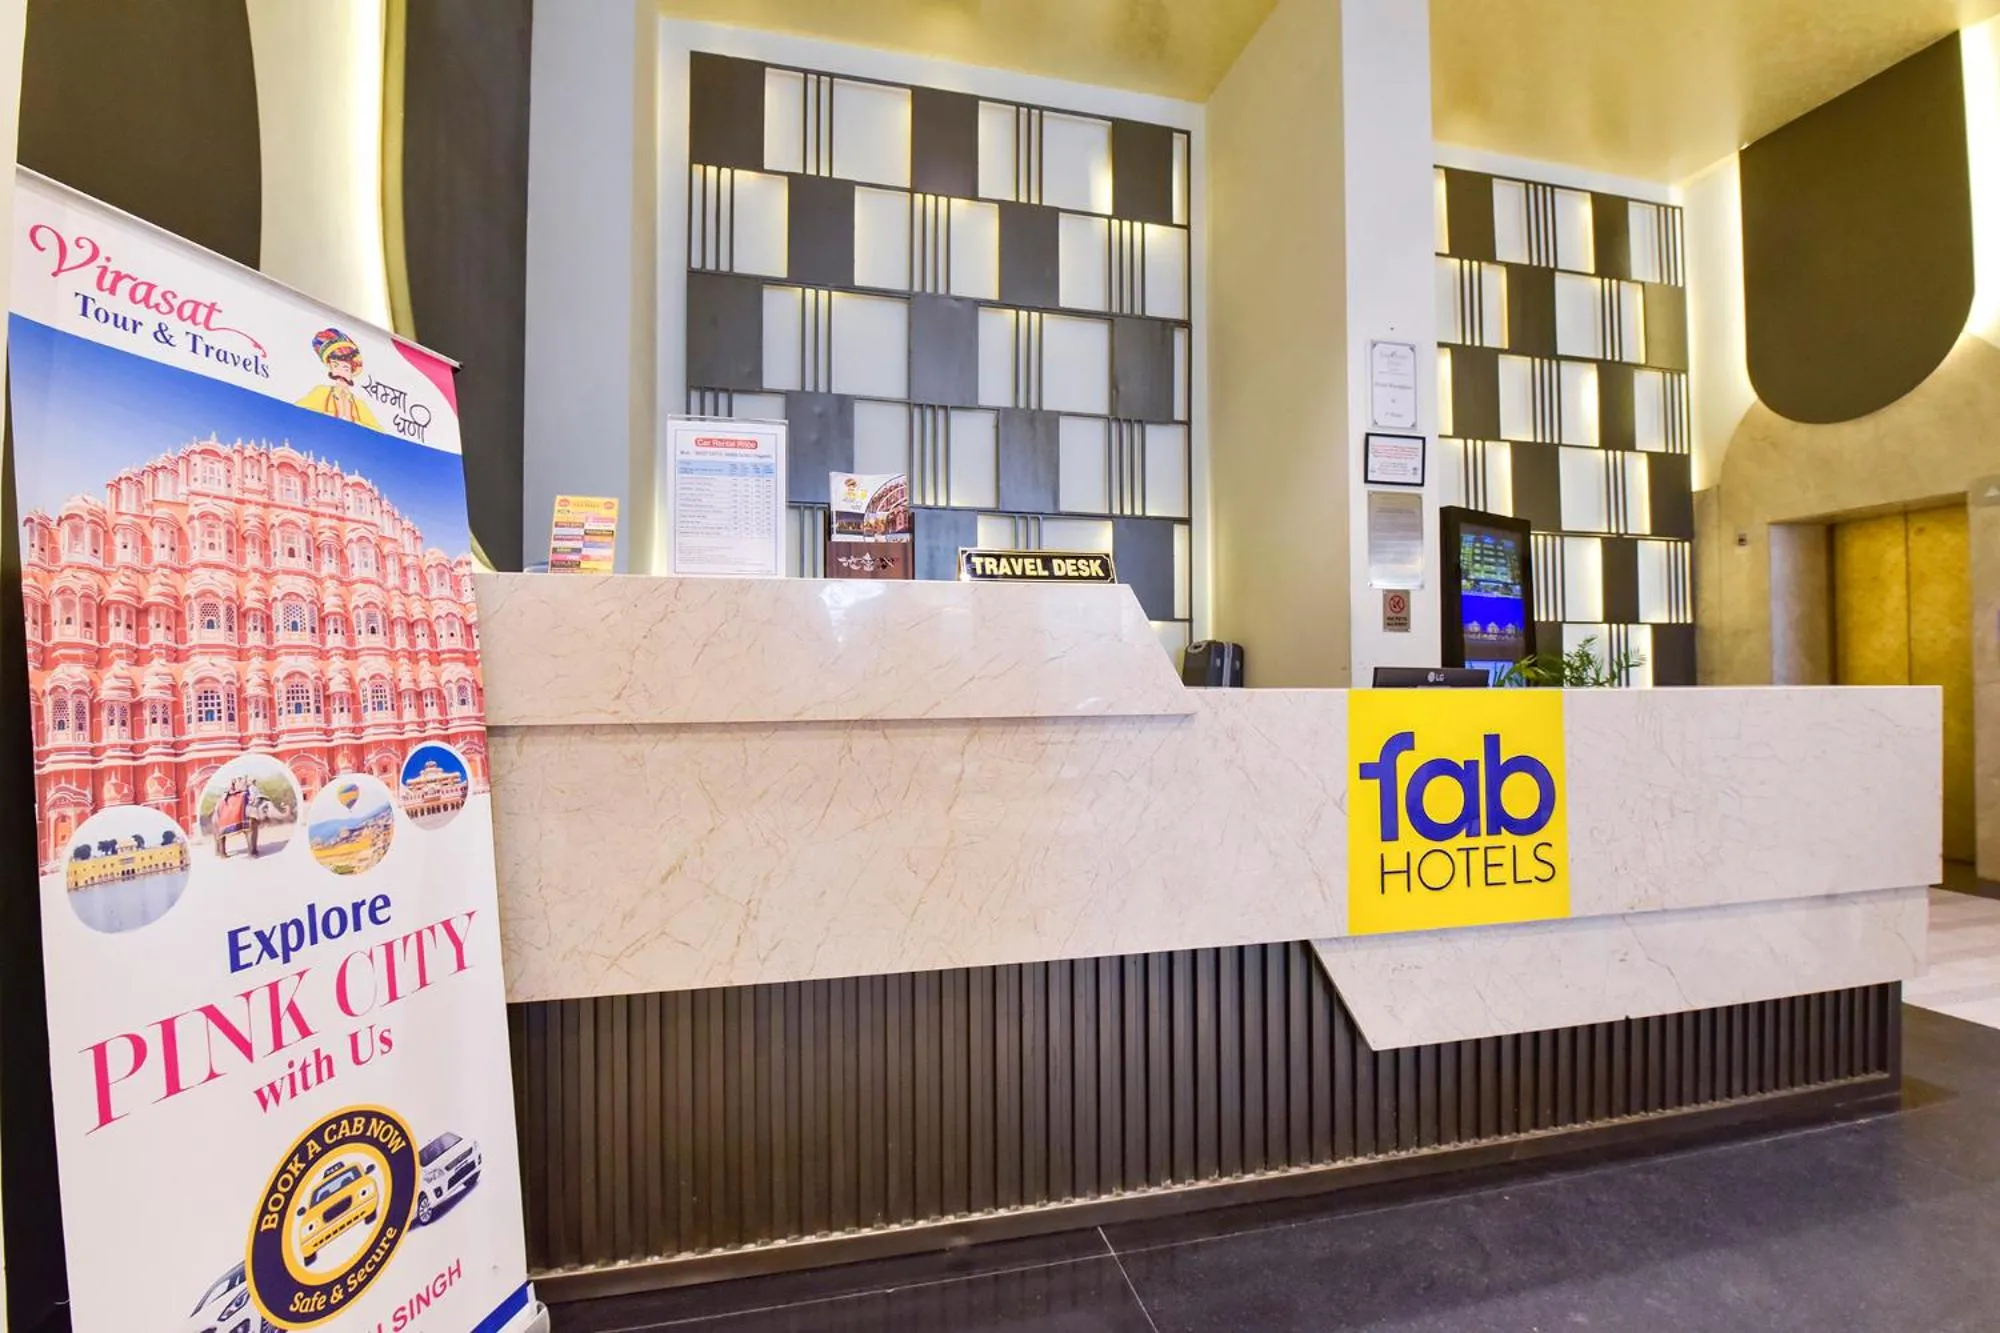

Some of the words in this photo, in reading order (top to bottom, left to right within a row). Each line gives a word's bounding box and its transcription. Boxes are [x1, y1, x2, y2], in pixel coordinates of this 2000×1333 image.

[29, 224, 267, 358] Virasat
[74, 291, 144, 335] Tour
[152, 321, 177, 348] &
[185, 331, 270, 379] Travels
[971, 556, 1049, 577] TRAVEL
[1052, 558, 1105, 577] DESK
[1359, 731, 1556, 842] fab
[1380, 842, 1556, 895] HOTELS
[227, 893, 392, 974] Explore
[78, 968, 321, 1136] PINK
[335, 909, 478, 1018] CITY
[253, 1047, 336, 1115] with
[349, 1023, 394, 1067] Us
[259, 1154, 306, 1232] BOOK
[305, 1138, 323, 1161] A
[323, 1116, 365, 1145] CAB
[366, 1117, 407, 1155] NOW
[289, 1291, 327, 1314] Safe
[330, 1284, 345, 1305] &
[346, 1226, 398, 1293] Secure
[391, 1257, 463, 1333] SINGH
